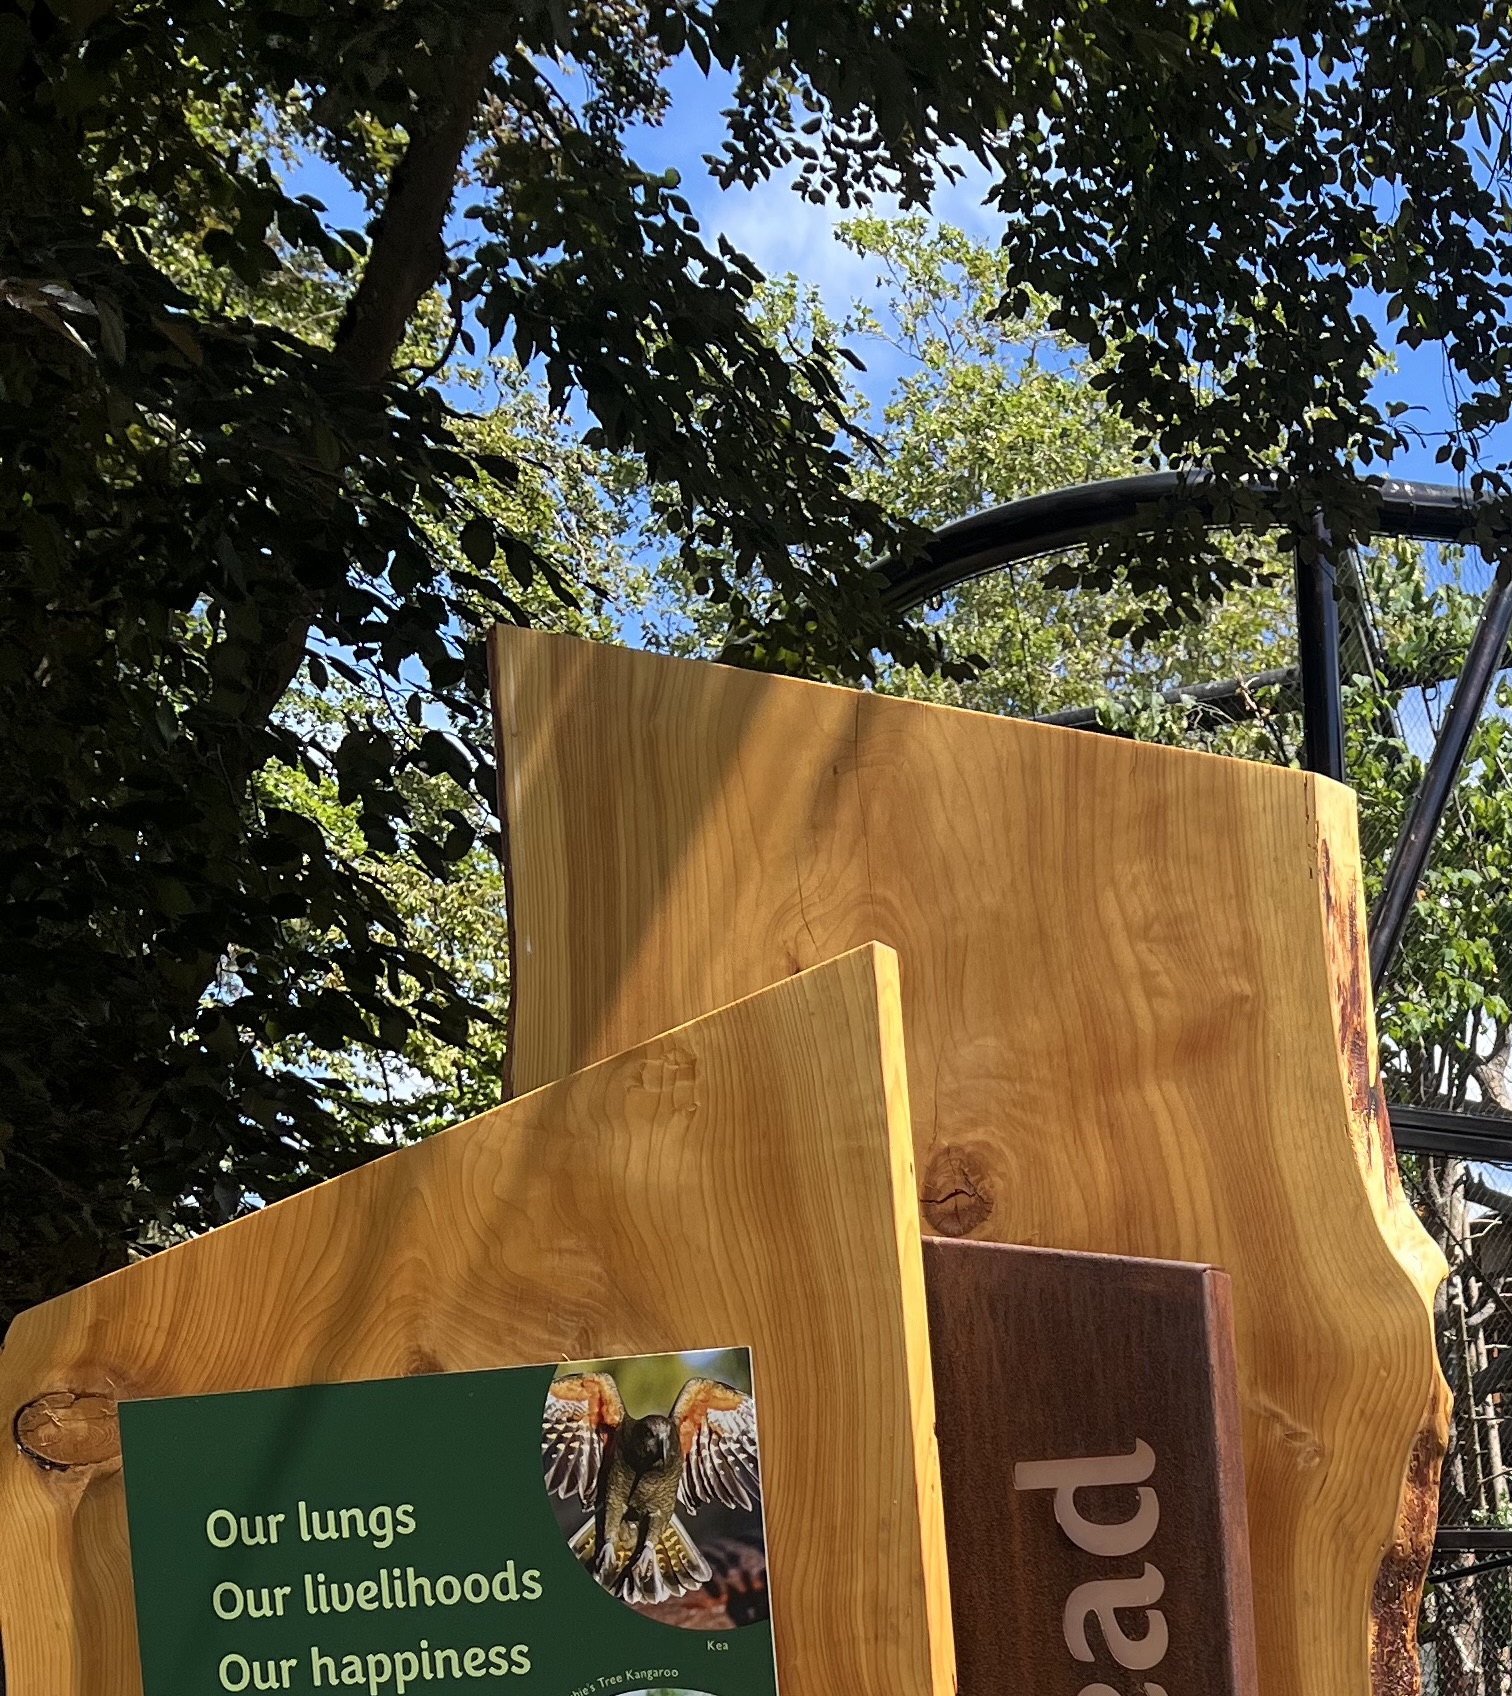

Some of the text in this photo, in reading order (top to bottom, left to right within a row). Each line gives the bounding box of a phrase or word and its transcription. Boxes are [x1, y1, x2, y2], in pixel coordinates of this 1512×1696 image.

[206, 1500, 416, 1549] Our lungs
[212, 1559, 543, 1620] Our livelihoods
[219, 1639, 531, 1696] Our happiness
[706, 1639, 730, 1652] Kea
[596, 1674, 623, 1690] Tree
[625, 1668, 680, 1682] Kangaroo
